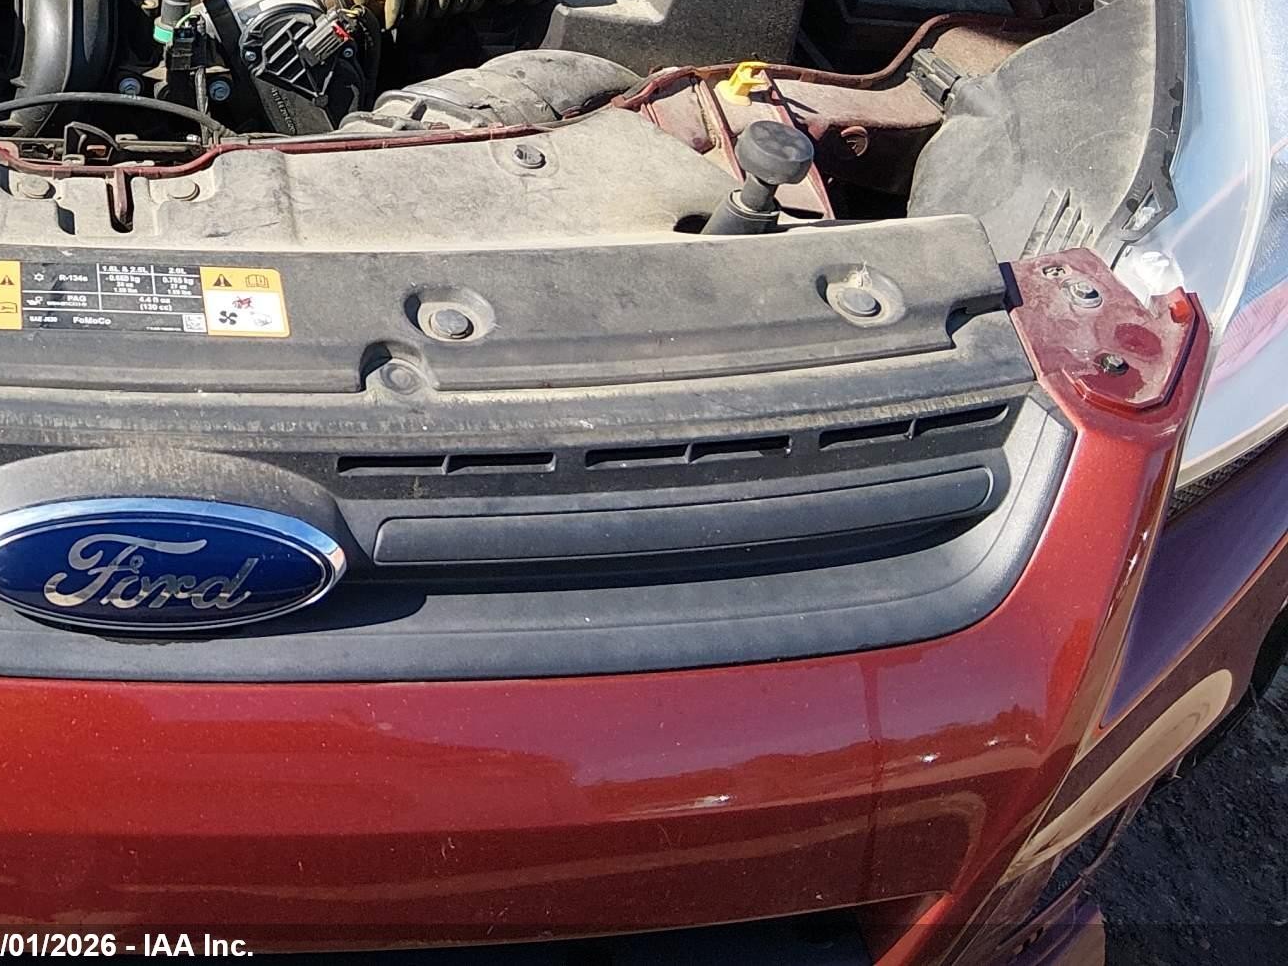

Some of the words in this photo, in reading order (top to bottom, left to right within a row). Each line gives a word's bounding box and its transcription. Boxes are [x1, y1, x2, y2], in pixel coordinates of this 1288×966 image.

[58, 274, 89, 282] R-134a
[72, 316, 112, 325] FoMoCo
[44, 533, 259, 610] Ford
